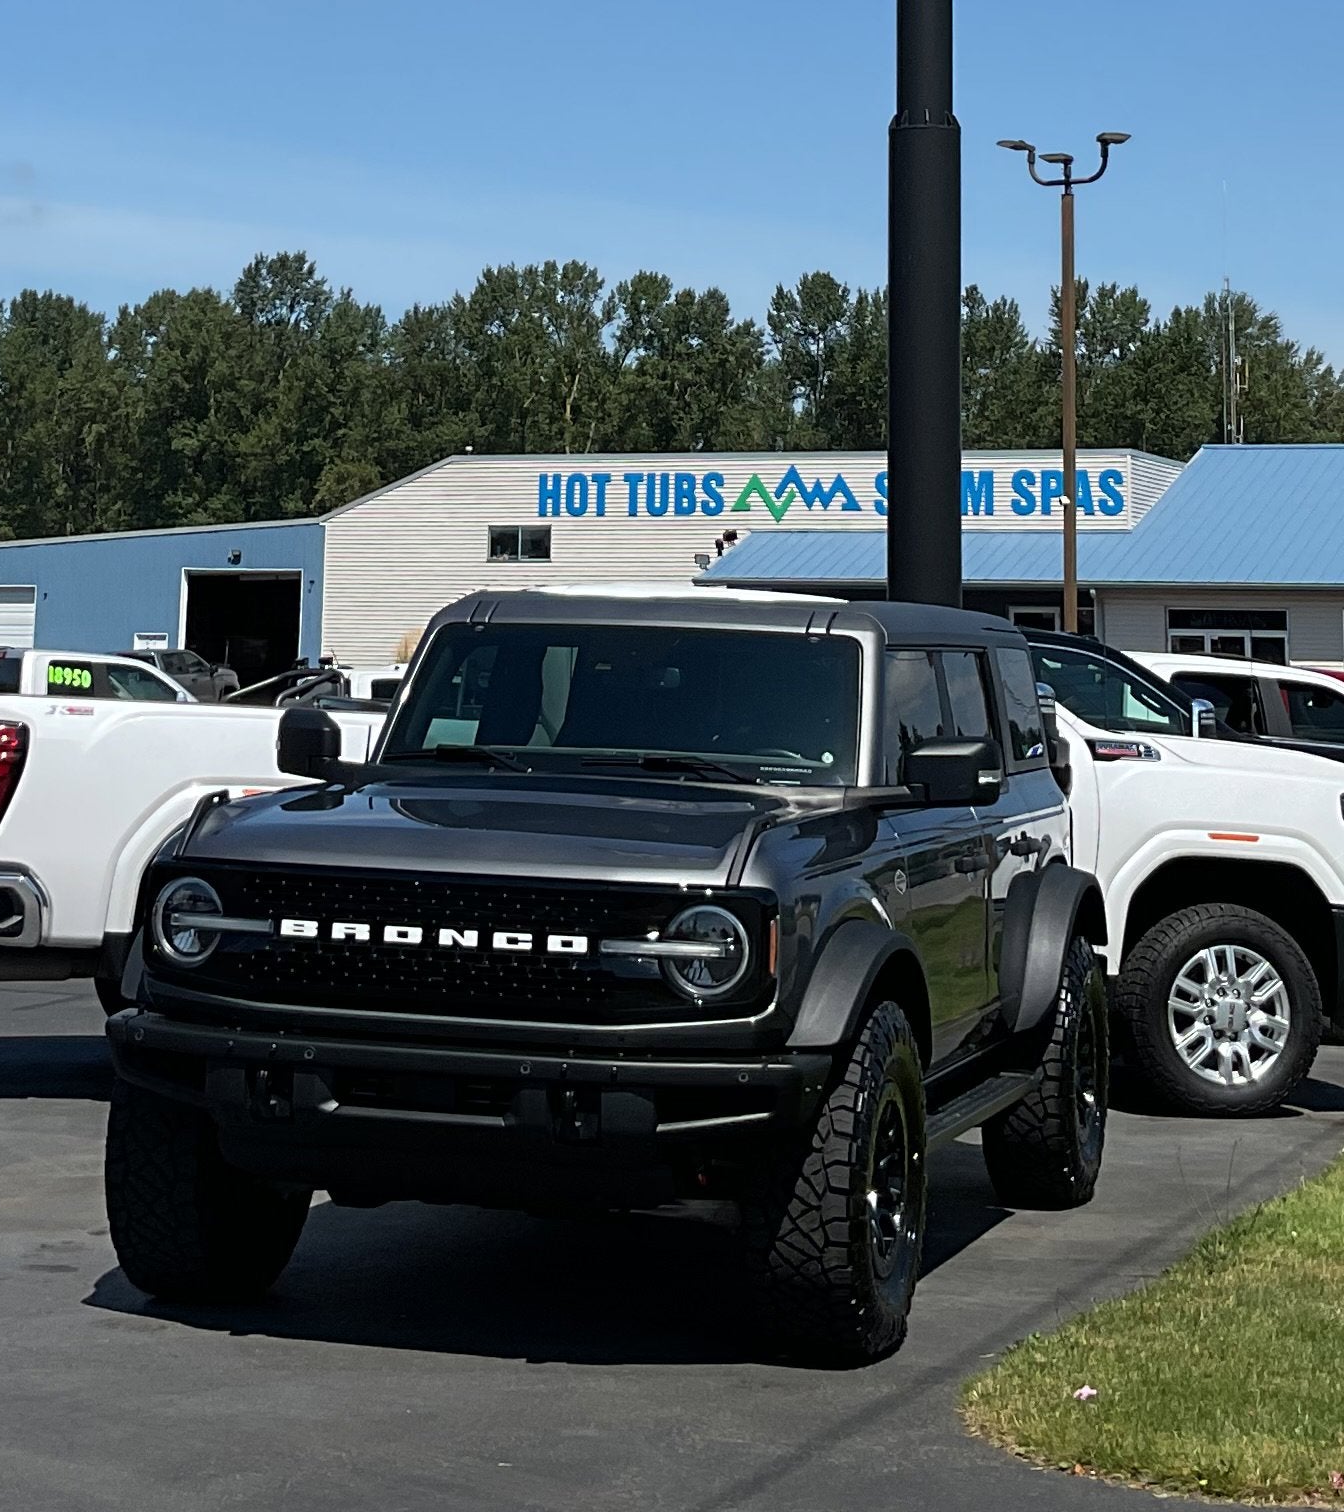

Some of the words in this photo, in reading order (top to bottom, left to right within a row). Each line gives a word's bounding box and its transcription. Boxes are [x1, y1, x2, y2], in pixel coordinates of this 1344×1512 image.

[538, 473, 612, 517] HOT
[624, 472, 724, 517] TUBS
[1011, 469, 1124, 516] SPAS
[48, 666, 92, 688] 18950
[280, 918, 588, 953] BRONCO
